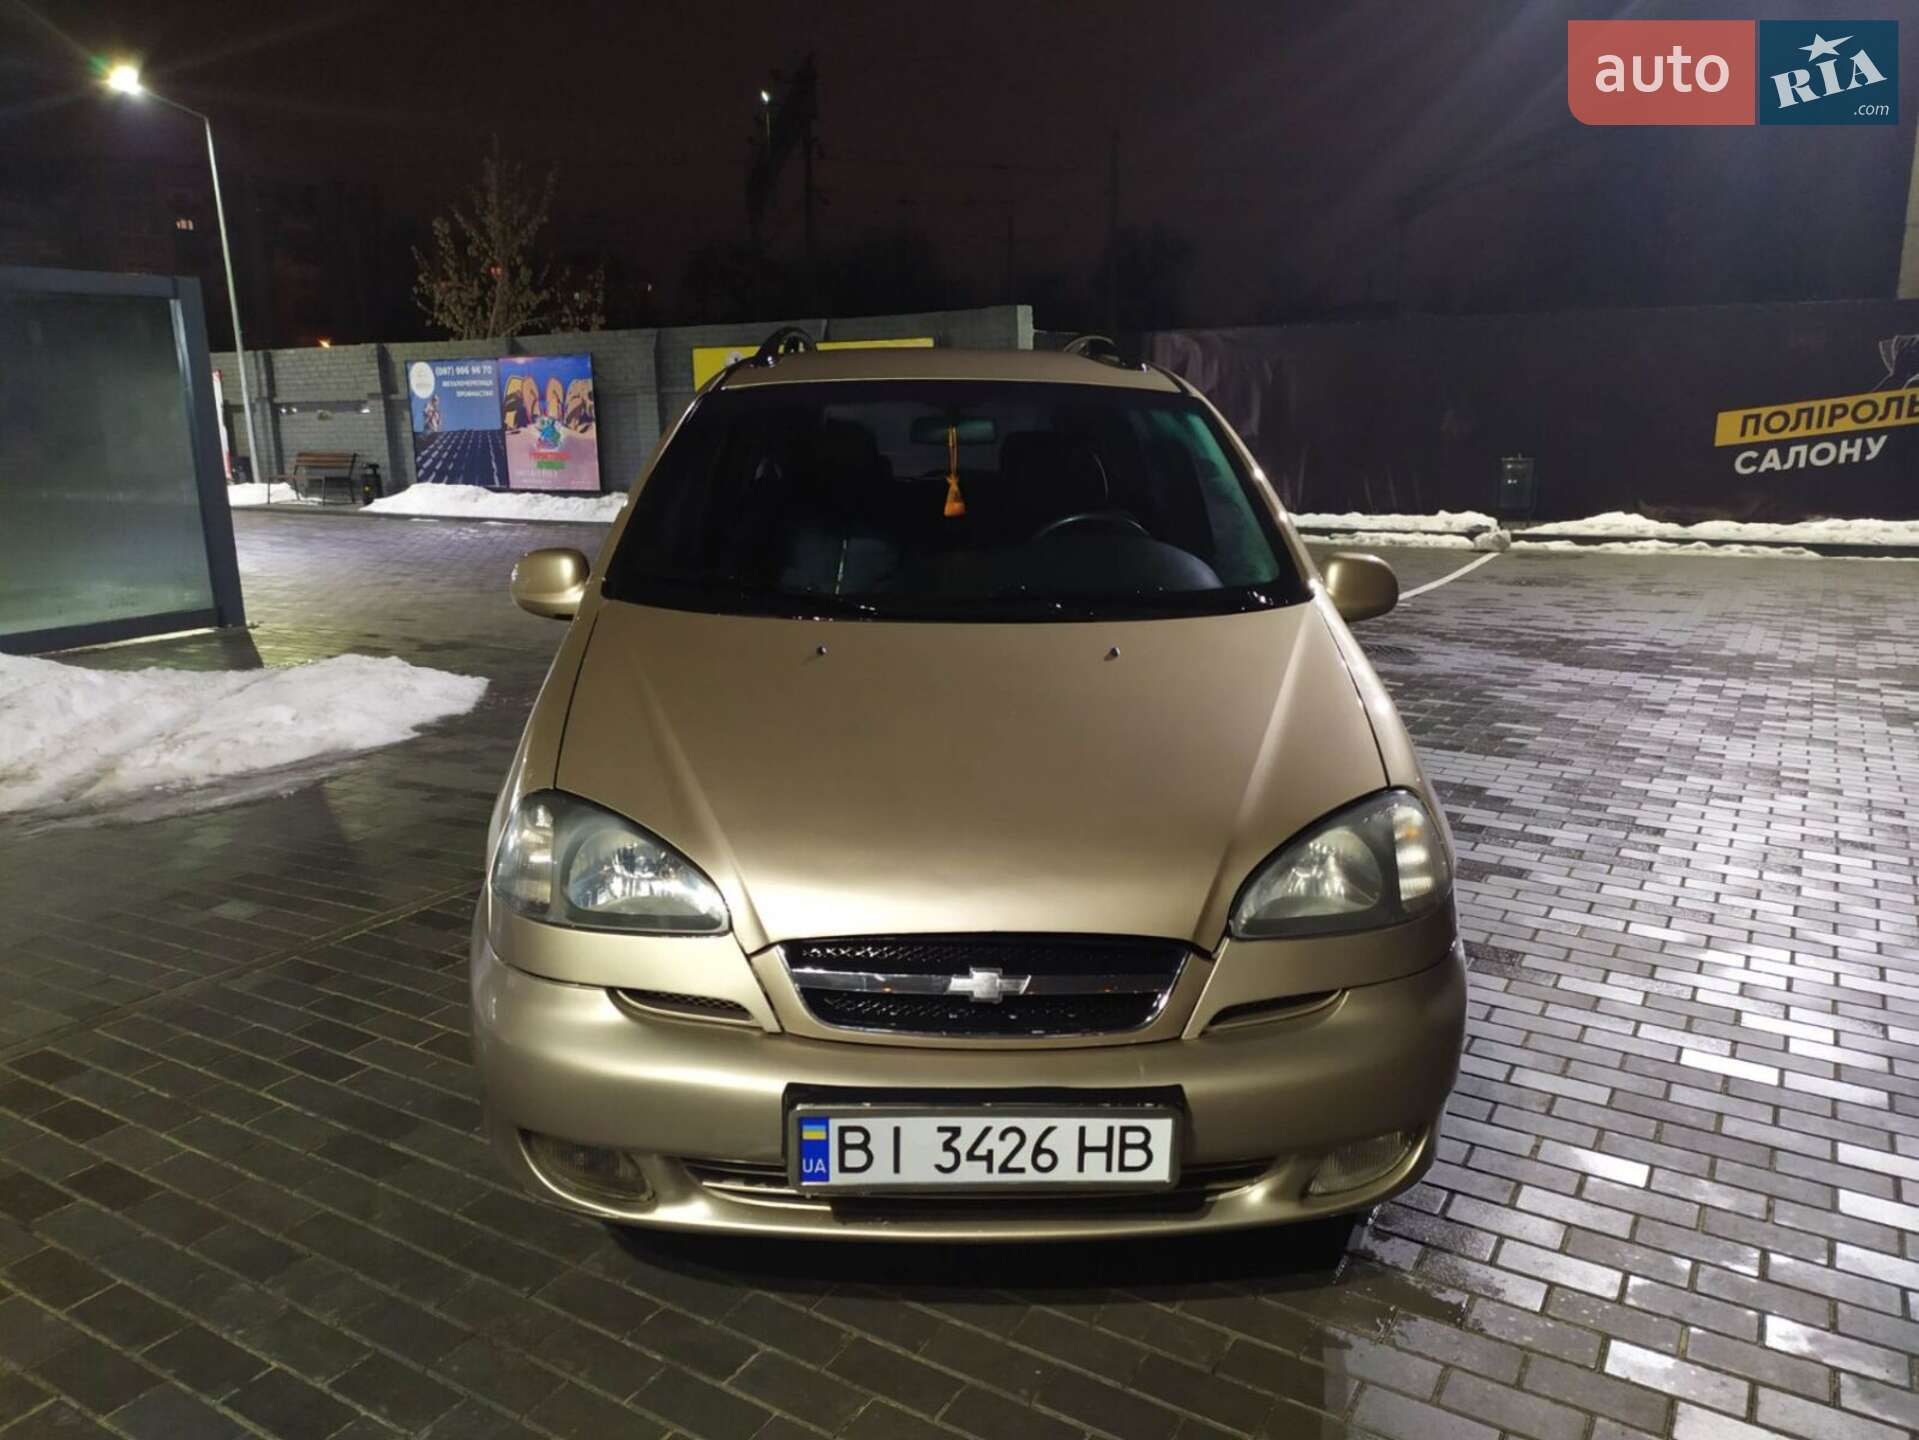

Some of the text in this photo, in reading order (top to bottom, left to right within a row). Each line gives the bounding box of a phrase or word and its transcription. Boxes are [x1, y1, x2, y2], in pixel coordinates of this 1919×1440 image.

[1734, 434, 1888, 475] САЛОНУ
[802, 1157, 827, 1174] UA
[934, 1125, 1060, 1174] 3426
[1077, 1125, 1154, 1174] HB
